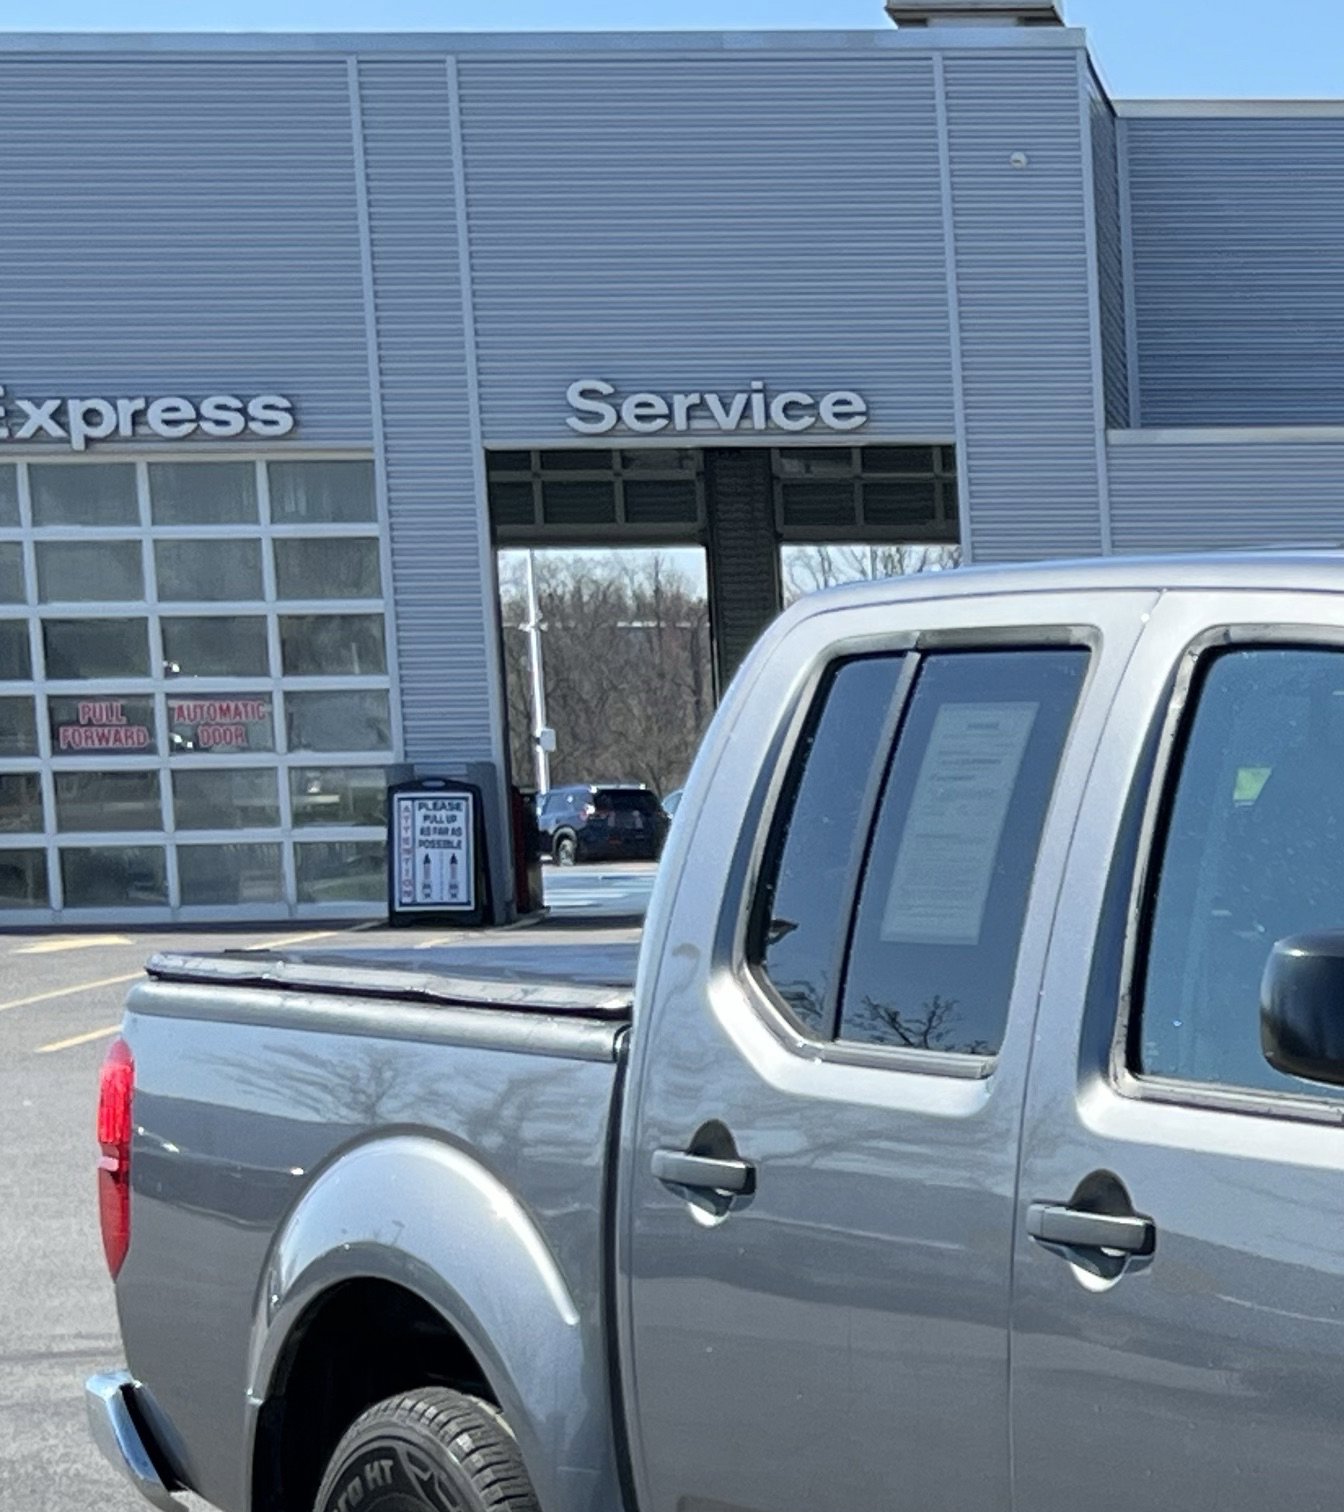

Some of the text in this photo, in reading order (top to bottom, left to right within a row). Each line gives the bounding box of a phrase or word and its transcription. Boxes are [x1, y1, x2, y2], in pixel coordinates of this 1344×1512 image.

[565, 378, 868, 434] Service
[79, 702, 126, 725] PULL
[174, 701, 267, 723] AUTOMATIC
[60, 727, 150, 750] FORWARD
[198, 726, 248, 747] DOOR
